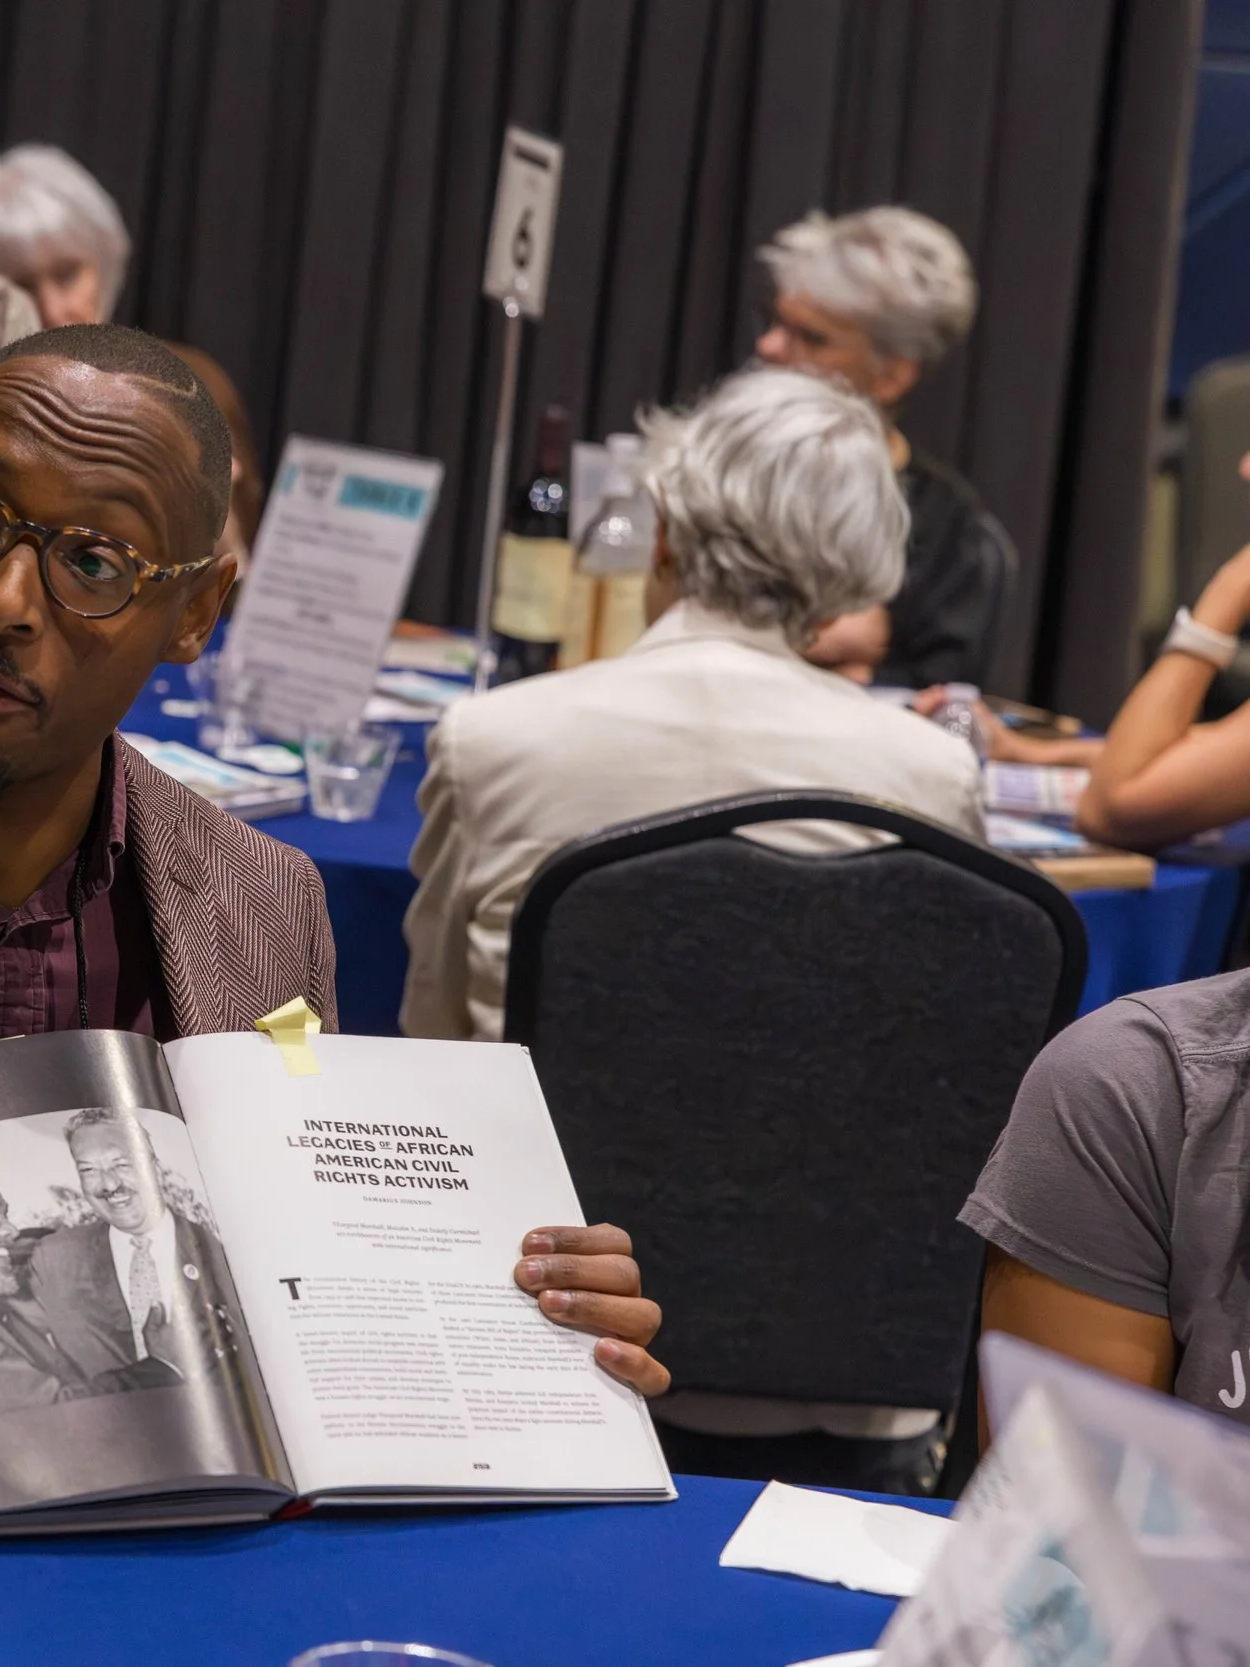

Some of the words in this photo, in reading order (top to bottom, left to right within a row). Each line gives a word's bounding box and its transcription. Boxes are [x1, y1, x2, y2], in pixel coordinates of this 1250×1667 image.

[303, 1119, 449, 1139] INTERNATIONAL
[286, 1135, 376, 1152] LEGACIES
[379, 1141, 392, 1149] OF
[396, 1142, 475, 1157] AFRICAN
[314, 1153, 408, 1171] AMERICAN
[411, 1159, 460, 1173] CIVIL
[313, 1170, 380, 1186] RIGHTS
[384, 1175, 470, 1191] ACTIVISM
